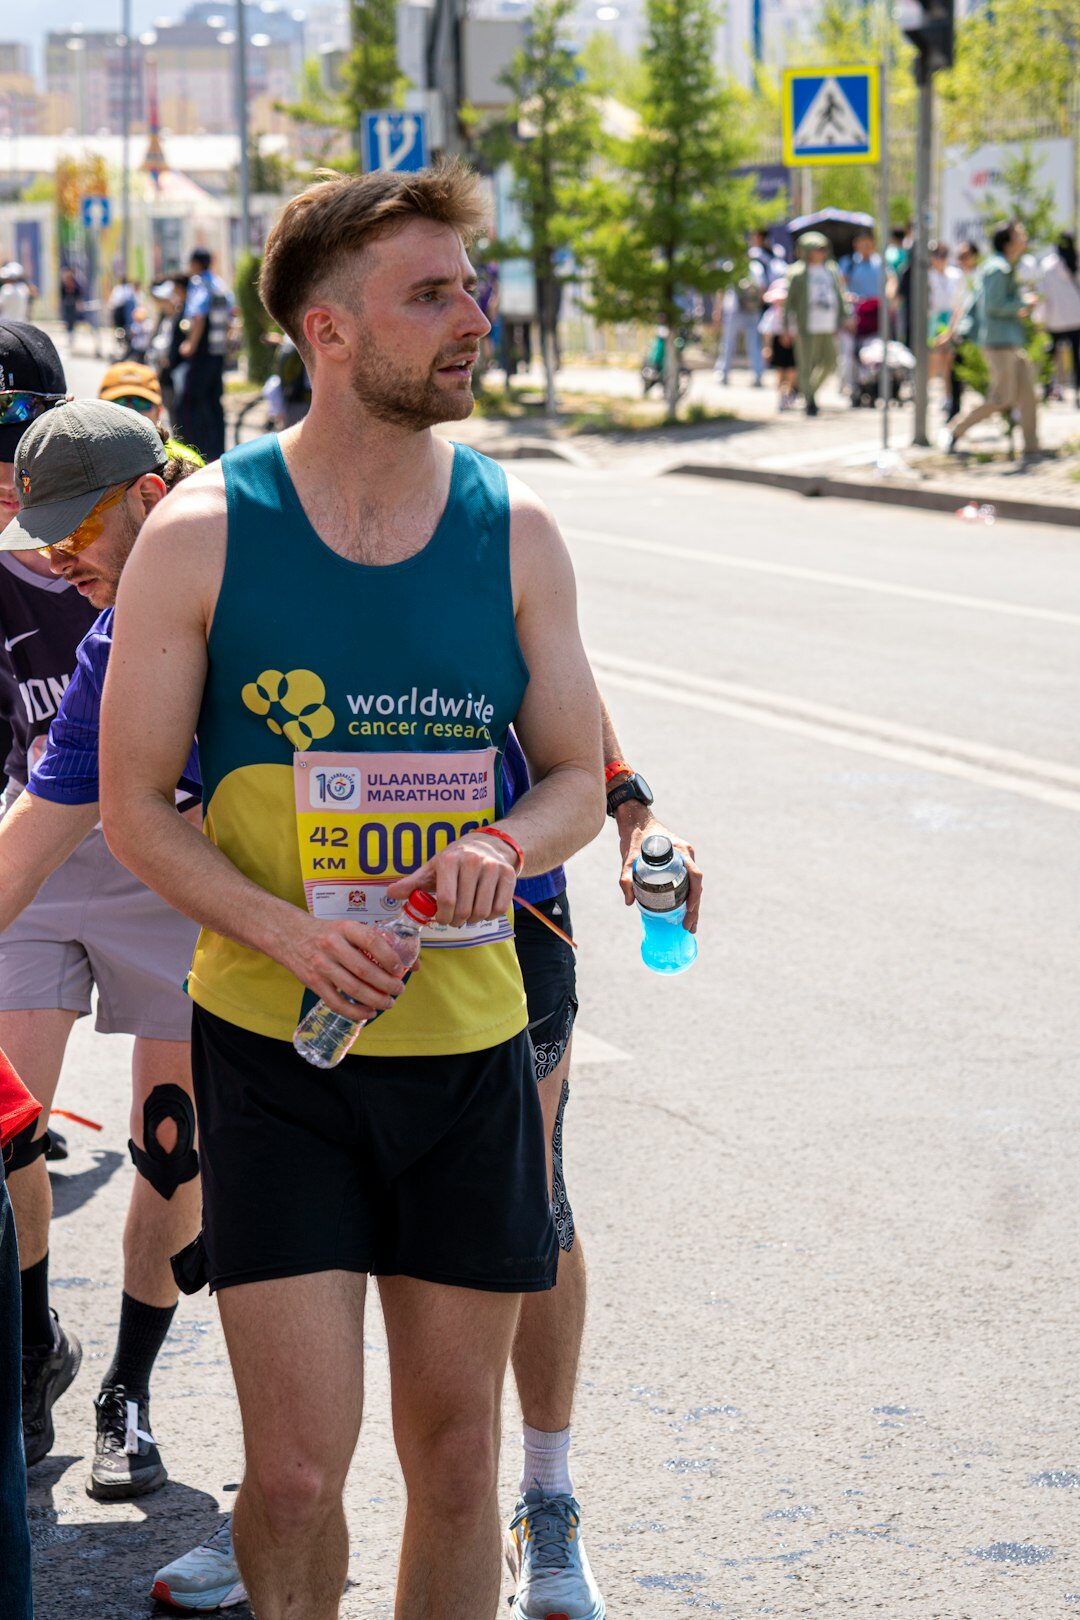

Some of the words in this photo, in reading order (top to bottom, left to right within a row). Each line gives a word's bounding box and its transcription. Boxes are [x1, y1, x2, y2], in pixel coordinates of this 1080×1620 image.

[346, 687, 494, 723] worldwide
[348, 721, 418, 736] cancer
[367, 788, 465, 802] MARATHON
[309, 826, 349, 848] 42
[312, 857, 346, 870] KM
